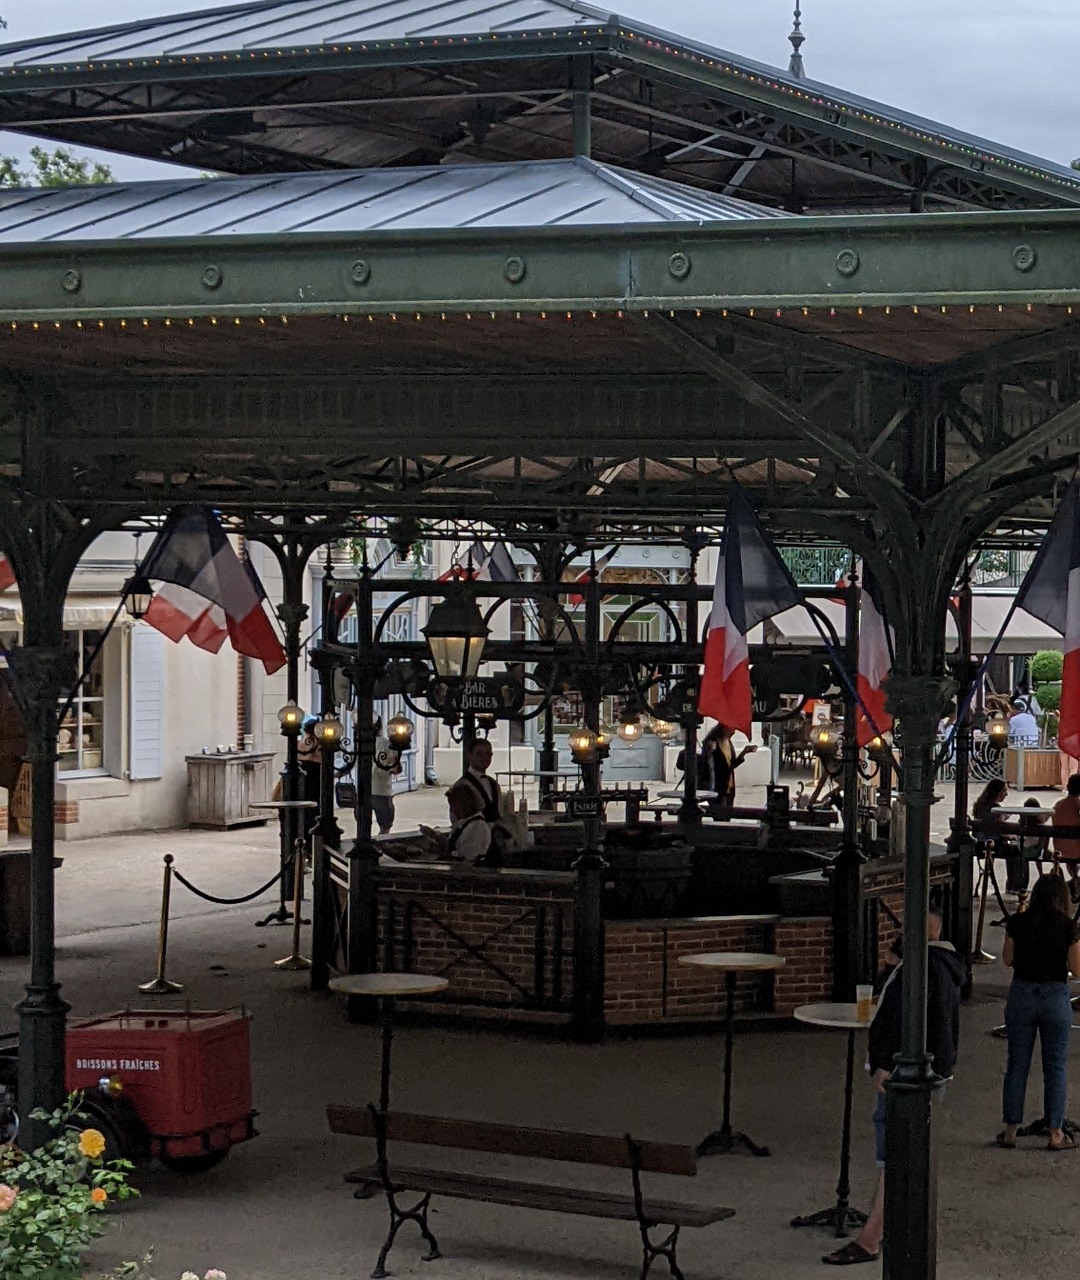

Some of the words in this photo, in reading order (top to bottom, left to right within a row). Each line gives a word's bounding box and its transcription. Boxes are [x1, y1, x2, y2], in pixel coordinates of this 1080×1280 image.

[463, 680, 486, 695] BAR
[76, 1058, 118, 1069] BOISSONS
[120, 1058, 160, 1071] FRAÎCHES
